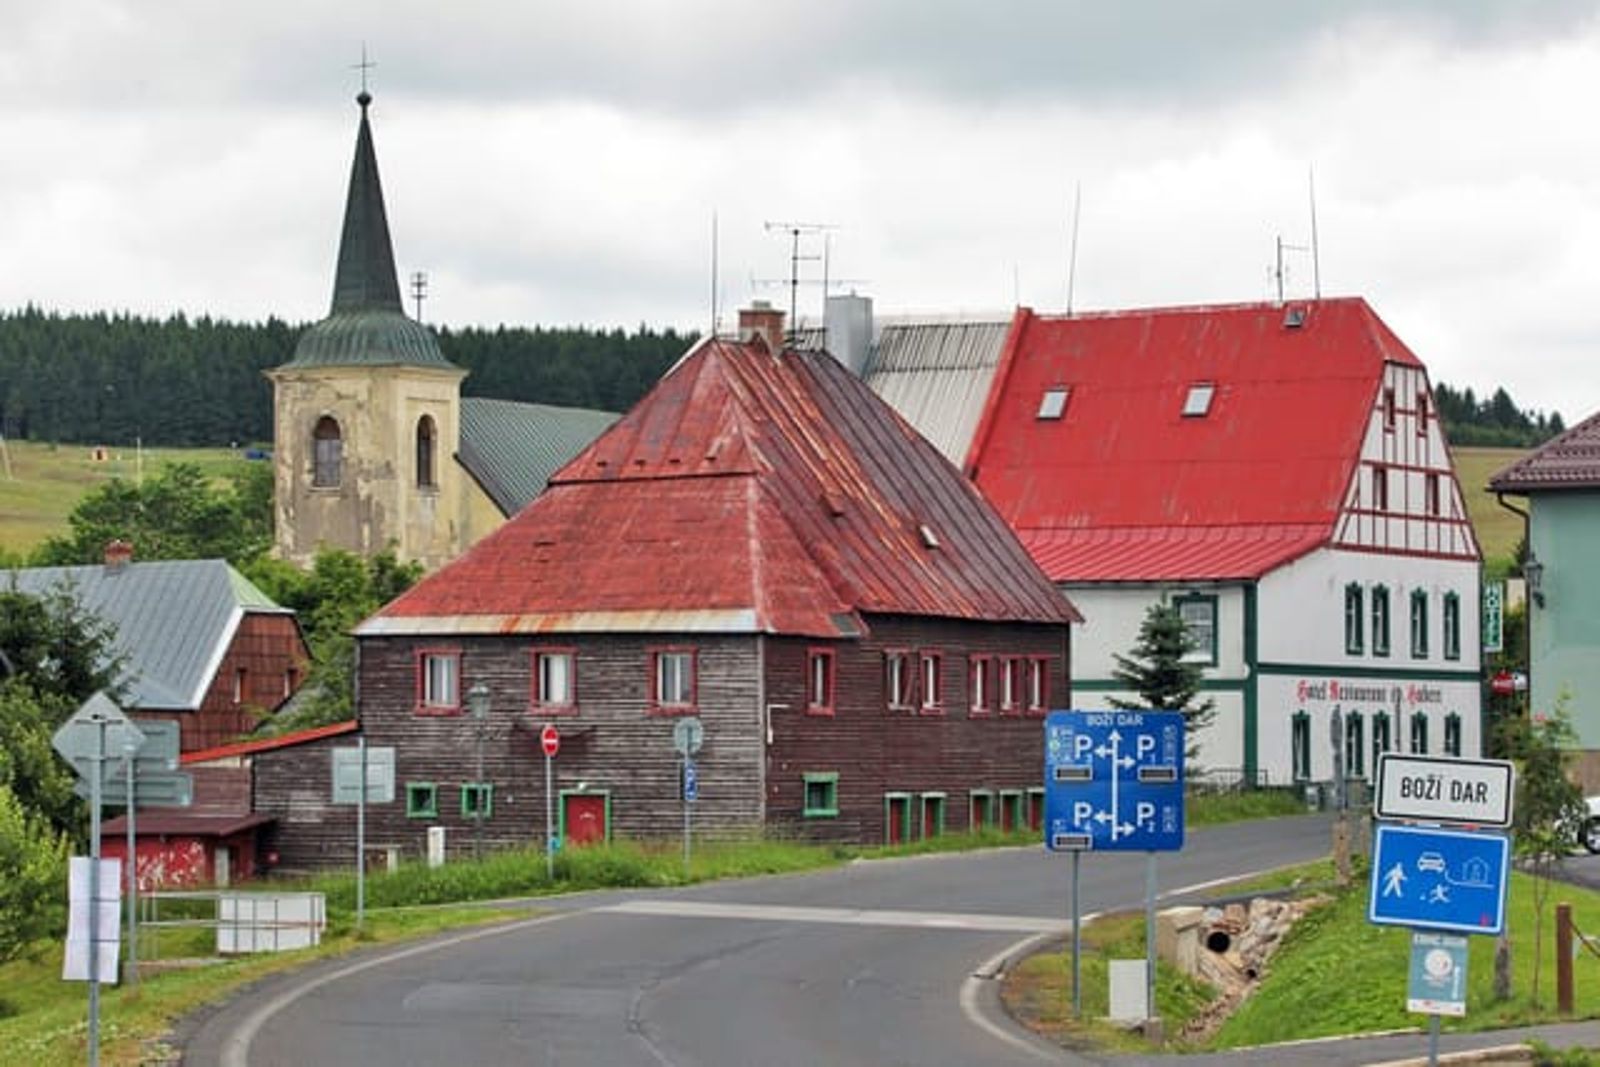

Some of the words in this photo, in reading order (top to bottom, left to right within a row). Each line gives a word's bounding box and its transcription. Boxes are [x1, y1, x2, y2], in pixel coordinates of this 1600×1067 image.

[1117, 713, 1144, 727] DAR
[1074, 734, 1093, 760] P
[1137, 734, 1156, 760] P
[1400, 774, 1444, 801] BOŽÍ
[1450, 779, 1488, 804] DAR
[1074, 801, 1093, 827] P
[1137, 801, 1156, 827] P
